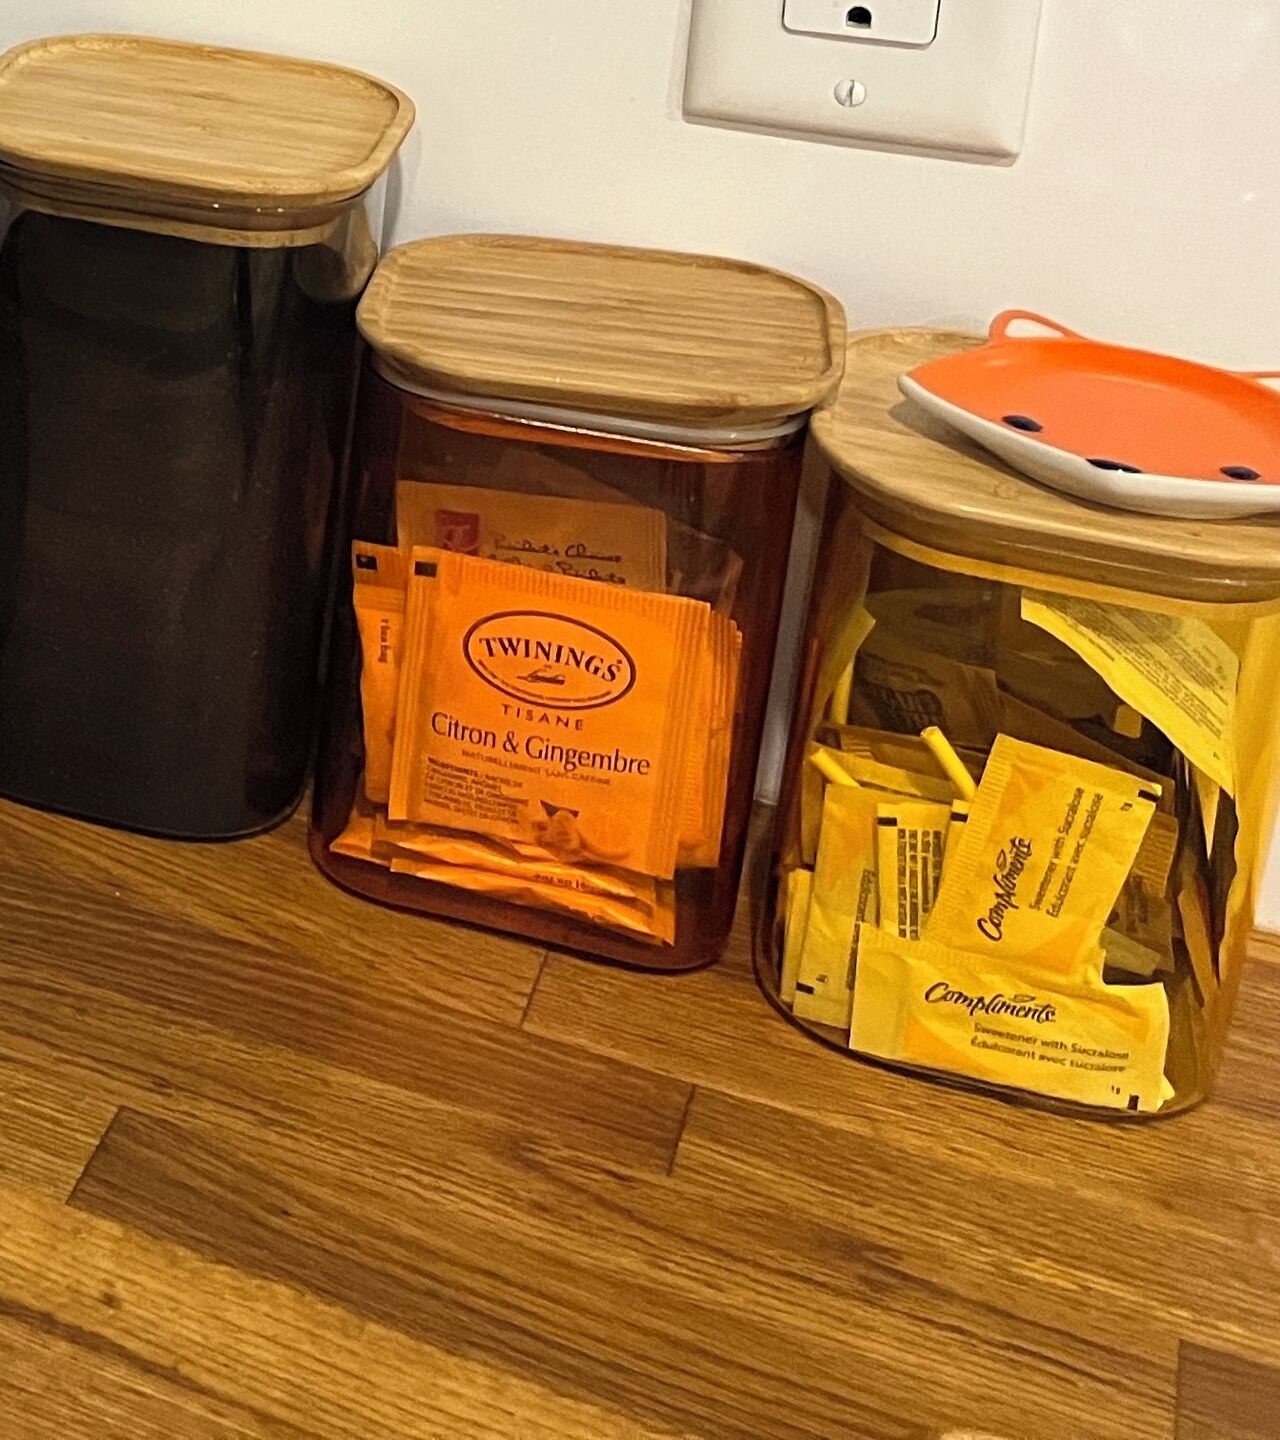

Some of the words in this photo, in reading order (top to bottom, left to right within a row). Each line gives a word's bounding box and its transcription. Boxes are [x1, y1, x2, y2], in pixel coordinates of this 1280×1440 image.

[479, 637, 621, 682] TWININGS
[502, 703, 584, 731] TISANE
[431, 711, 496, 749] Citron
[502, 731, 520, 755] &
[525, 734, 651, 776] Gingembre
[1058, 787, 1085, 836] Sucralose
[1052, 836, 1066, 859] with
[976, 836, 1033, 942] Compliments
[1029, 860, 1057, 911] Sweetener
[925, 982, 1057, 1024] Compliments
[970, 1035, 1035, 1060] Édulcorant
[1038, 1054, 1066, 1068] avec
[1069, 1058, 1126, 1073] sucralose
[974, 1022, 1038, 1045] Sweetener
[1040, 1038, 1068, 1051] with
[1071, 1042, 1130, 1060] Sucralose
